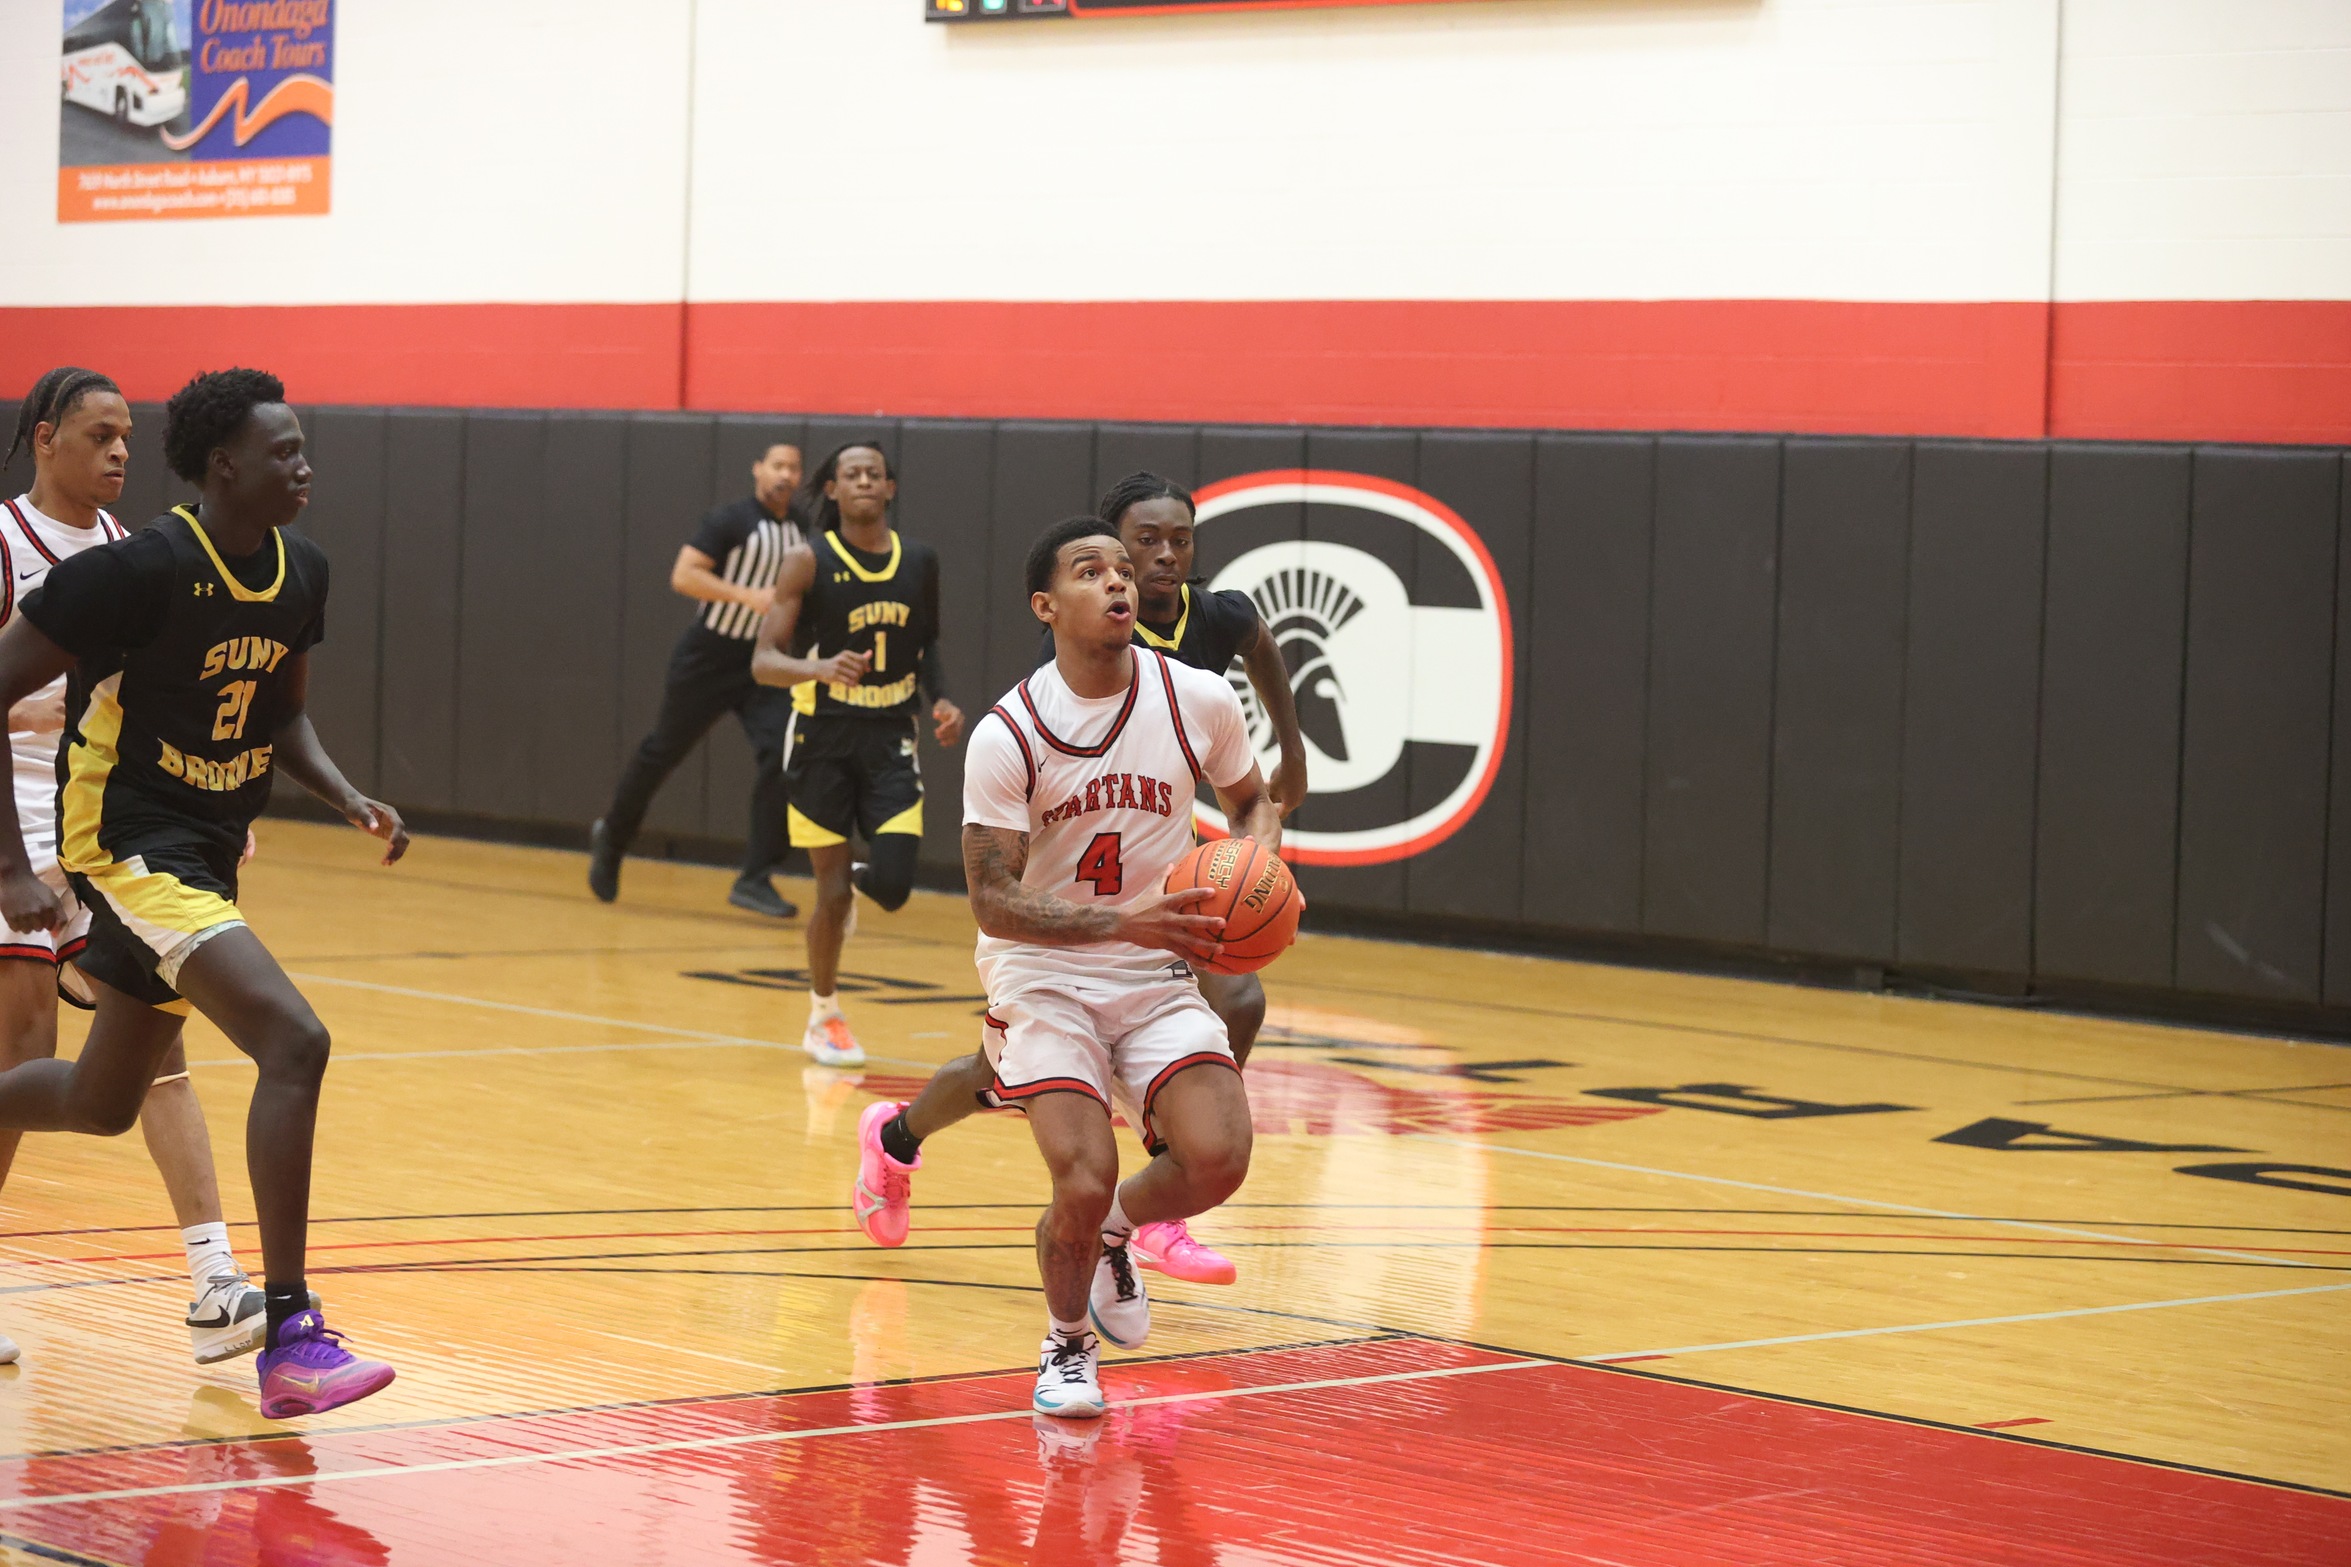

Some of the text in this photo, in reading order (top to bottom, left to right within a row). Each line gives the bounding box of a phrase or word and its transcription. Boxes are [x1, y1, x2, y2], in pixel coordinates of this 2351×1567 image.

[199, 0, 328, 40] Onondaga
[200, 34, 326, 73] Coach Tours
[848, 601, 910, 634] SUNY
[200, 636, 289, 681] SUNY
[874, 630, 886, 672] 1
[211, 680, 257, 741] 21
[157, 737, 273, 791] BROOME
[1041, 773, 1172, 827] SPARTANS
[1075, 832, 1123, 896] 4
[1215, 839, 1243, 890] EGACY
